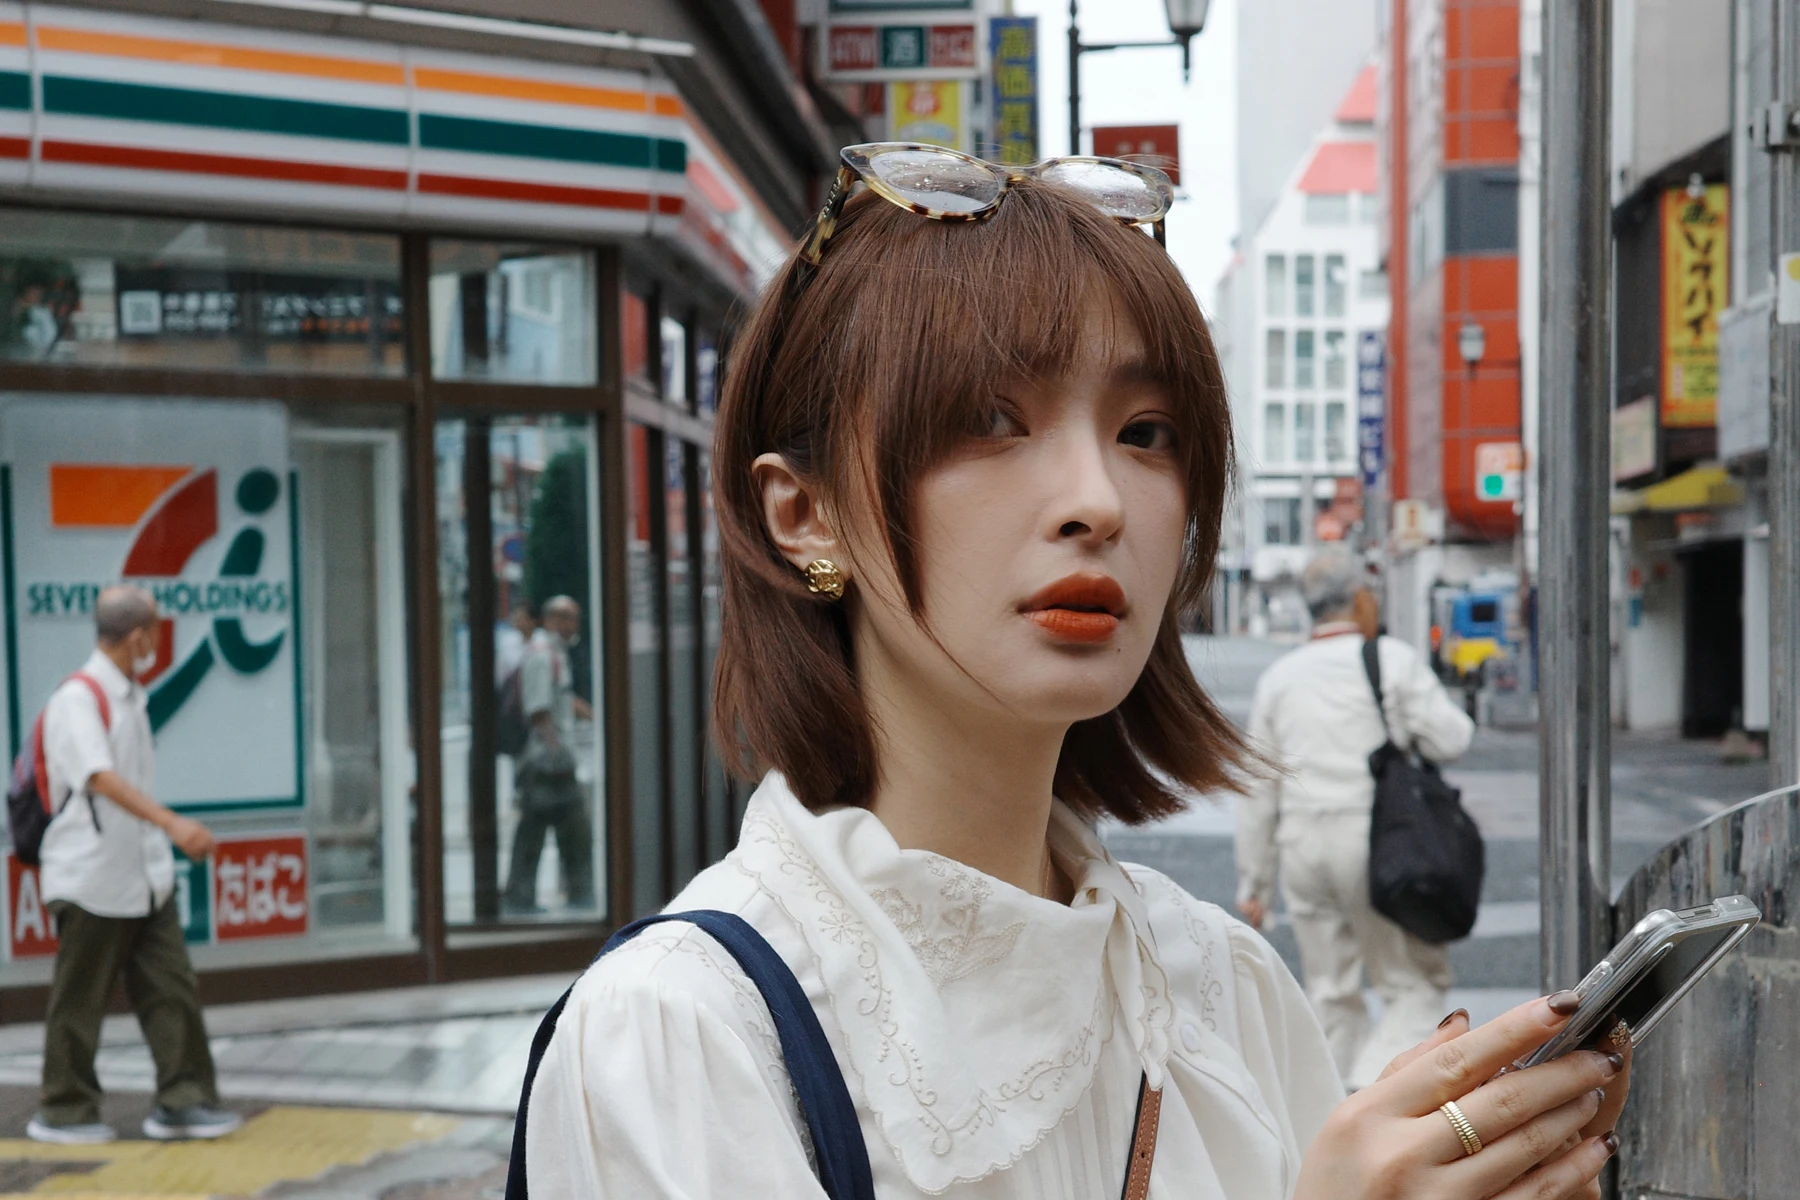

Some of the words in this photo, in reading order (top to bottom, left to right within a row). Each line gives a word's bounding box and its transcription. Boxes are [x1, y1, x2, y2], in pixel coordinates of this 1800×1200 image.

[152, 581, 287, 614] HOLDINGS
[218, 852, 304, 925] たばこ
